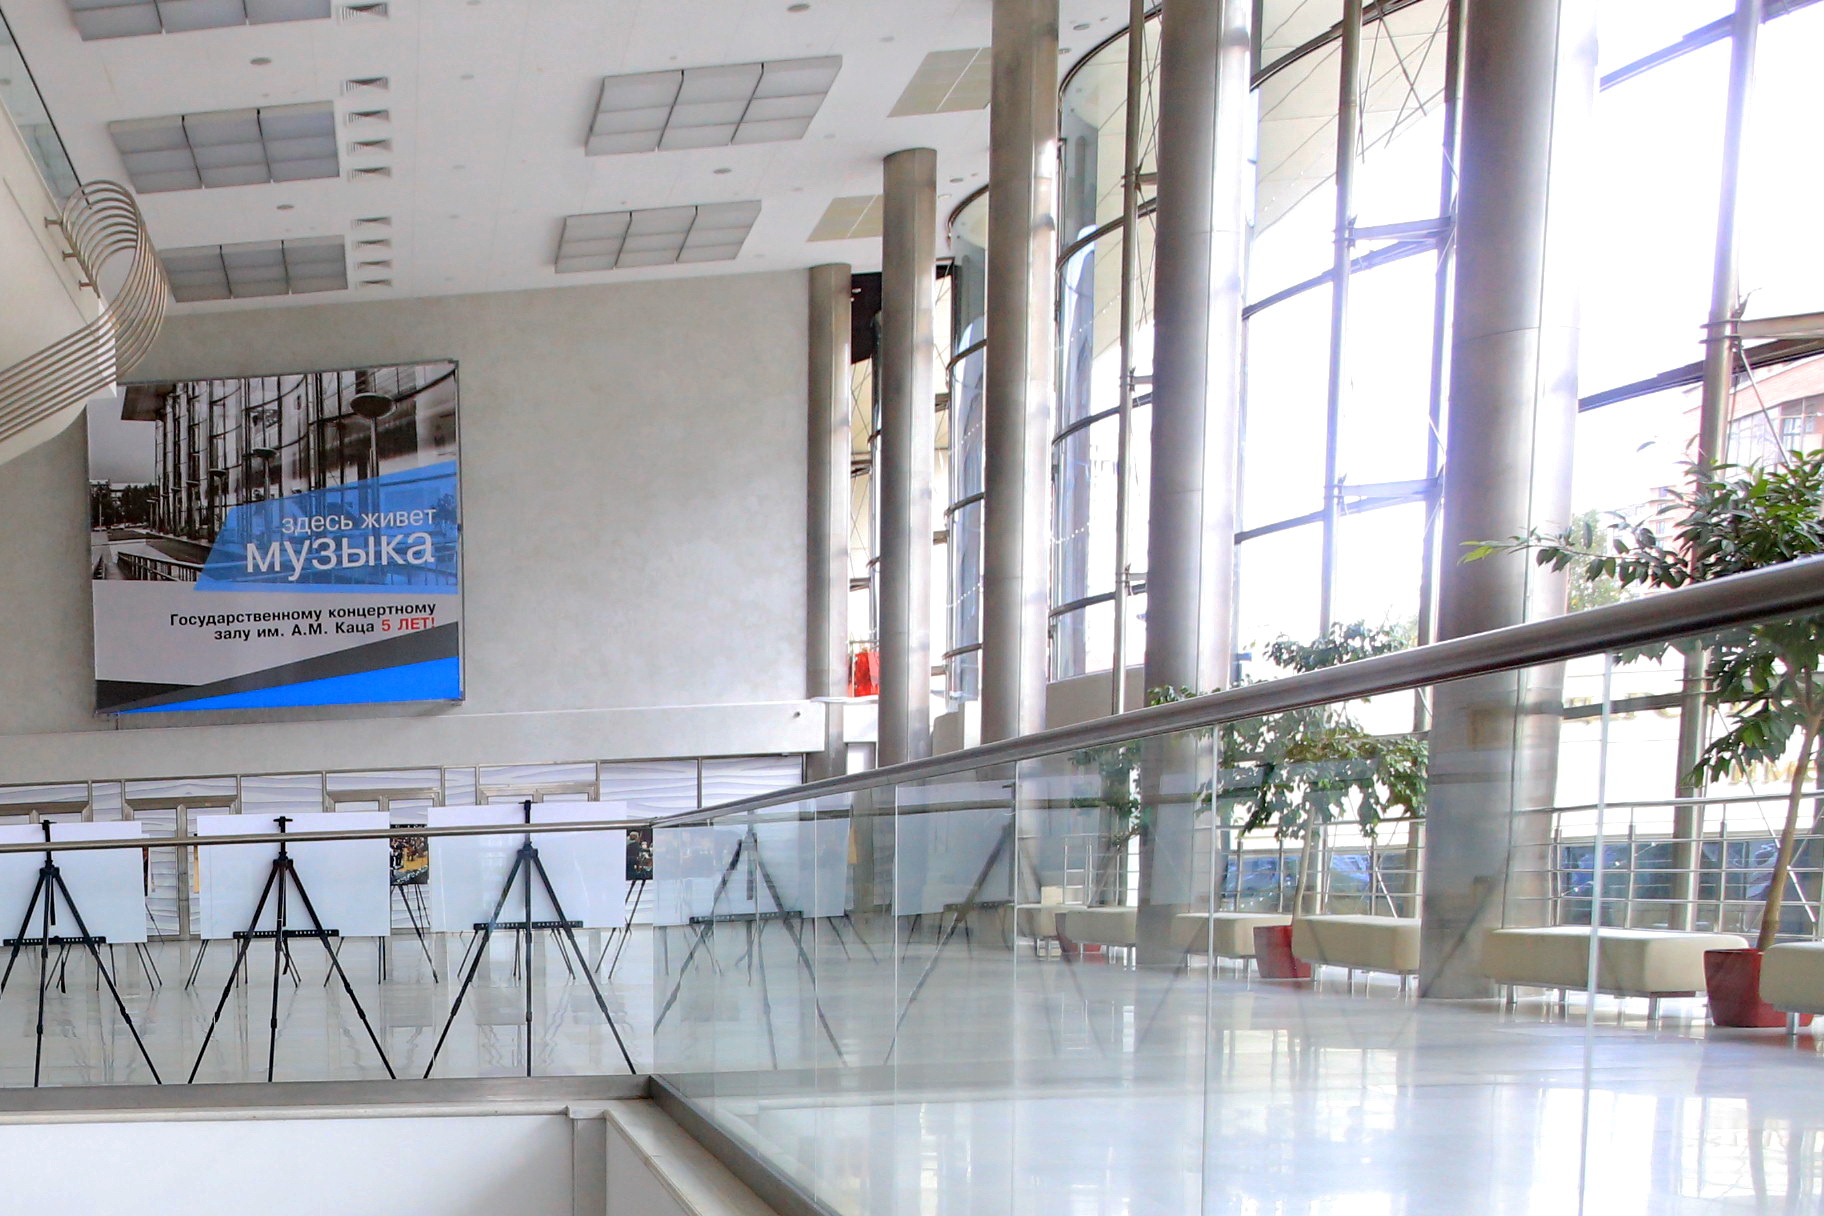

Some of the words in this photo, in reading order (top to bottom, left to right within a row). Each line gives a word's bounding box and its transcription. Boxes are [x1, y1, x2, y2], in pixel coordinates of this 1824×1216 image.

[282, 512, 353, 536] здесь
[361, 508, 437, 529] живет
[246, 531, 436, 582] музыка
[170, 608, 323, 627] Государственному
[328, 602, 437, 620] концертному
[214, 628, 251, 642] залу
[257, 626, 285, 639] им.
[291, 623, 329, 637] А.М.
[335, 620, 375, 636] Каца
[381, 618, 392, 632] 5
[397, 616, 437, 631] ЛЕТ!
